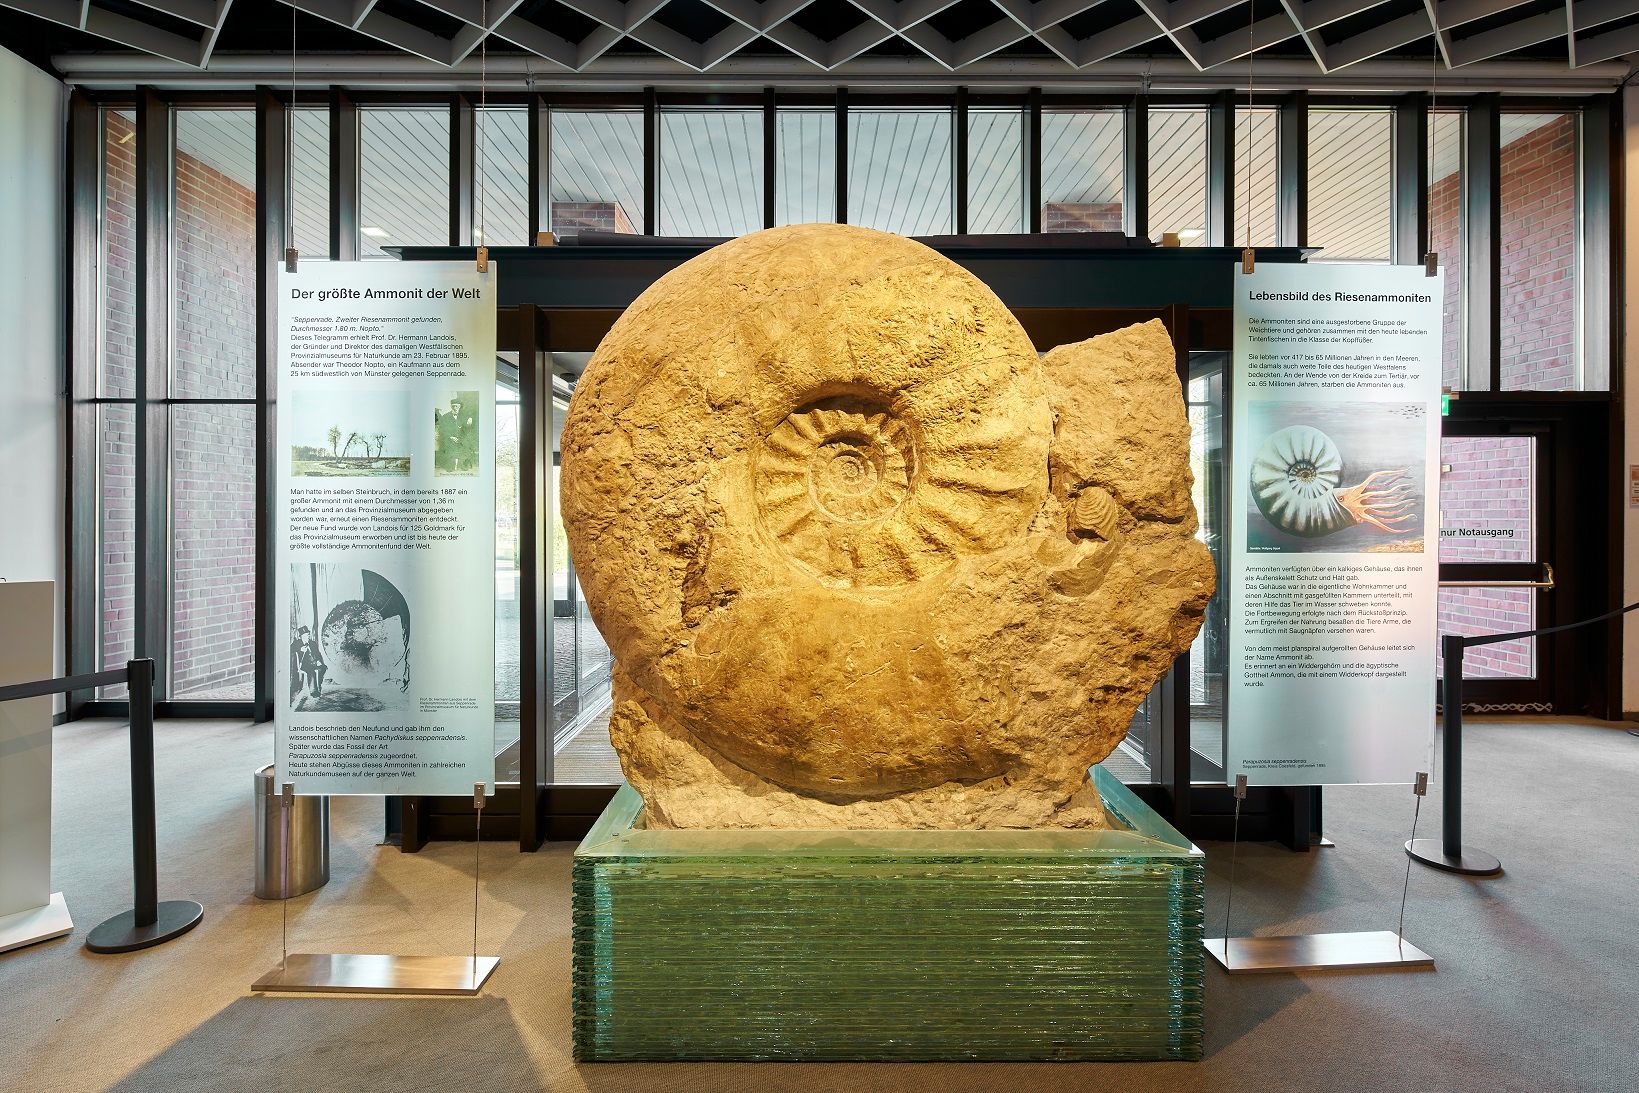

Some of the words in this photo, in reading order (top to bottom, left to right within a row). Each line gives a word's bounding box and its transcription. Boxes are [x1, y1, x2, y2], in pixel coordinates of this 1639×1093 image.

[292, 288, 314, 299] Der
[318, 288, 361, 301] größte
[364, 288, 423, 299] Ammonit
[427, 288, 448, 299] der
[452, 288, 480, 299] Welt
[1249, 291, 1308, 301] Lebensbild
[1312, 292, 1331, 302] des
[1334, 292, 1431, 303] Riesenammoniten
[1326, 318, 1370, 327] ausgestorbene
[1372, 319, 1395, 327] Gruppe
[314, 334, 348, 342] Telegramm
[384, 343, 417, 351] damaligen
[391, 370, 424, 378] gelegenen
[290, 497, 311, 506] großer
[1459, 528, 1514, 537] Notausgang
[289, 543, 310, 551] größte
[312, 543, 349, 551] vollständige
[404, 725, 417, 733] gab
[288, 743, 310, 751] Später
[332, 761, 360, 770] Abgüsse
